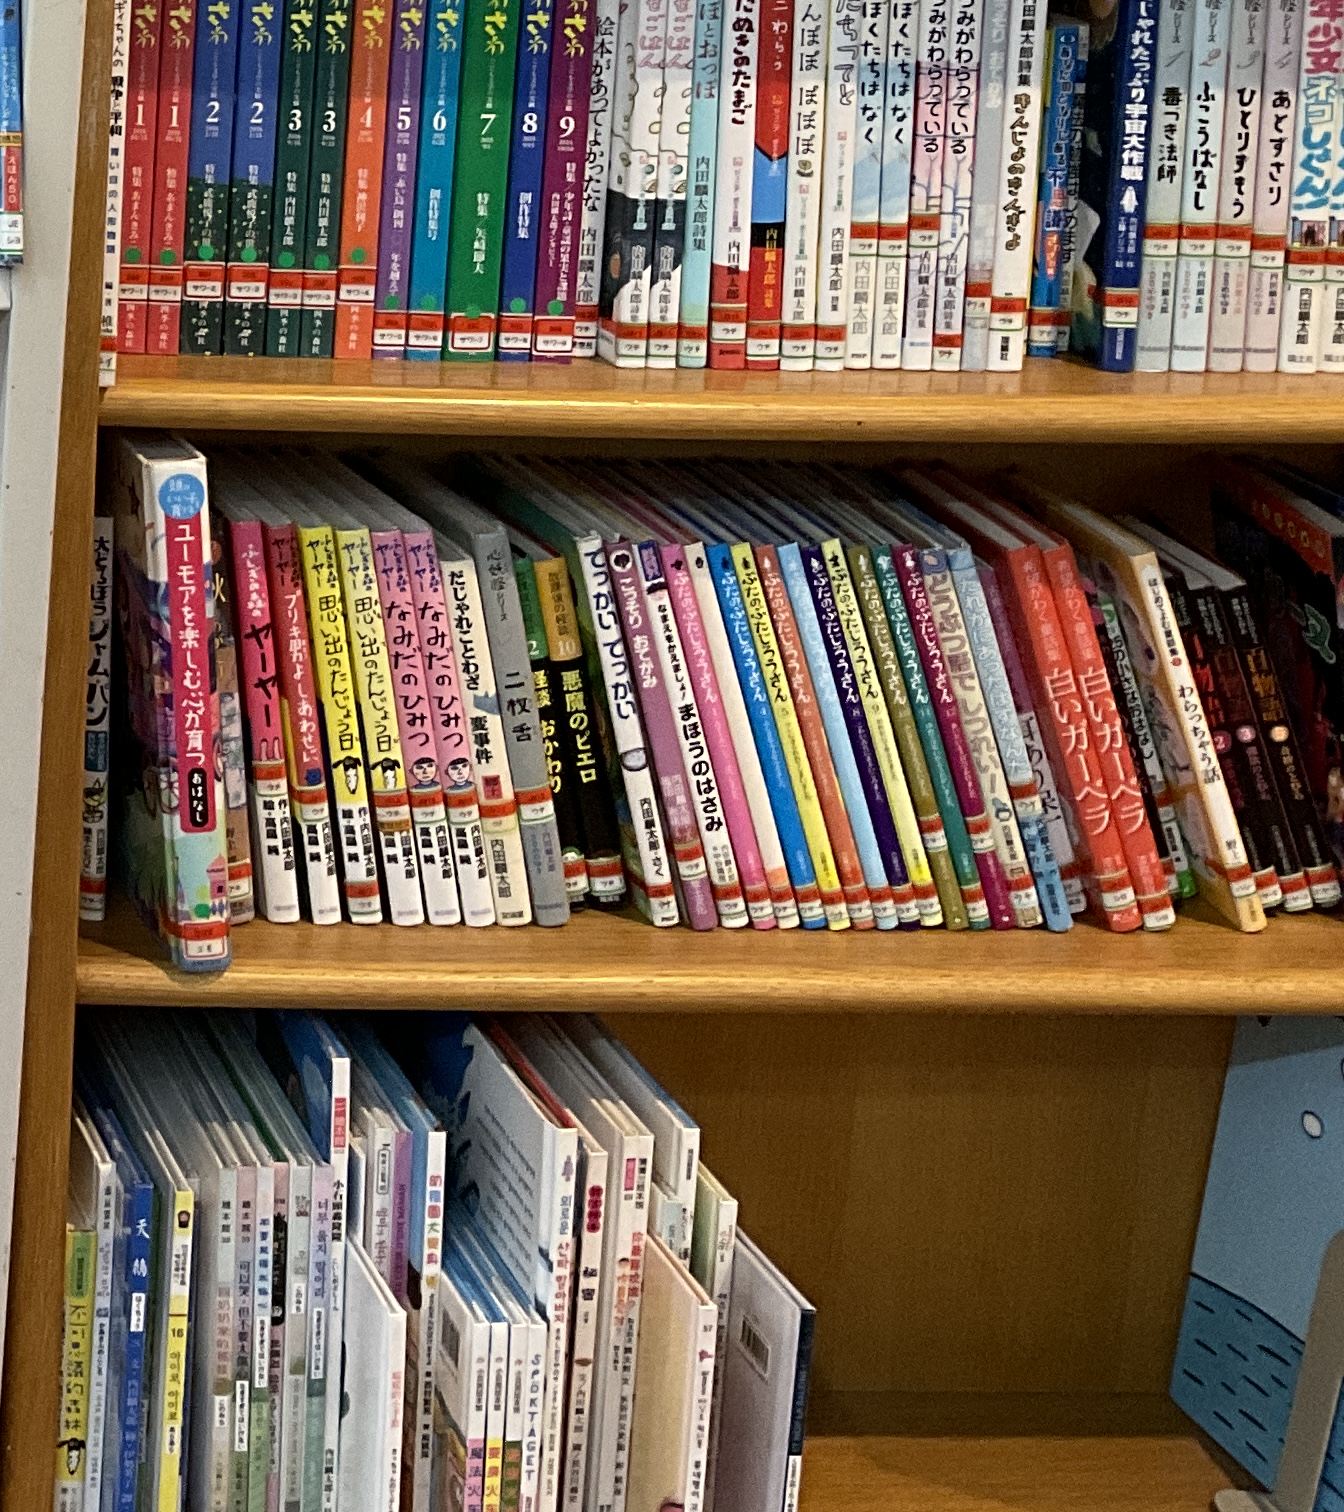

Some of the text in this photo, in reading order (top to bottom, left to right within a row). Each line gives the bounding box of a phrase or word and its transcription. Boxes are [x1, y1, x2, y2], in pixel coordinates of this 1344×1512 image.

[205, 101, 221, 123] 2
[289, 109, 303, 131] 3
[396, 107, 412, 131] 5
[479, 113, 497, 135] 7
[559, 115, 576, 137] 9
[581, 15, 615, 213] 絵本があってよかったな
[859, 0, 884, 144] ぼくたちはなく
[171, 523, 208, 766] ユーモアを楽しむ心が育つ
[245, 623, 277, 727] ヤーヤー
[385, 601, 430, 746] なみだのひみつ
[562, 671, 597, 783] 悪魔のピエロ
[678, 703, 723, 832] まほうのはさみ
[1044, 669, 1112, 834] 白いガーベラ
[191, 772, 204, 823] おはなし
